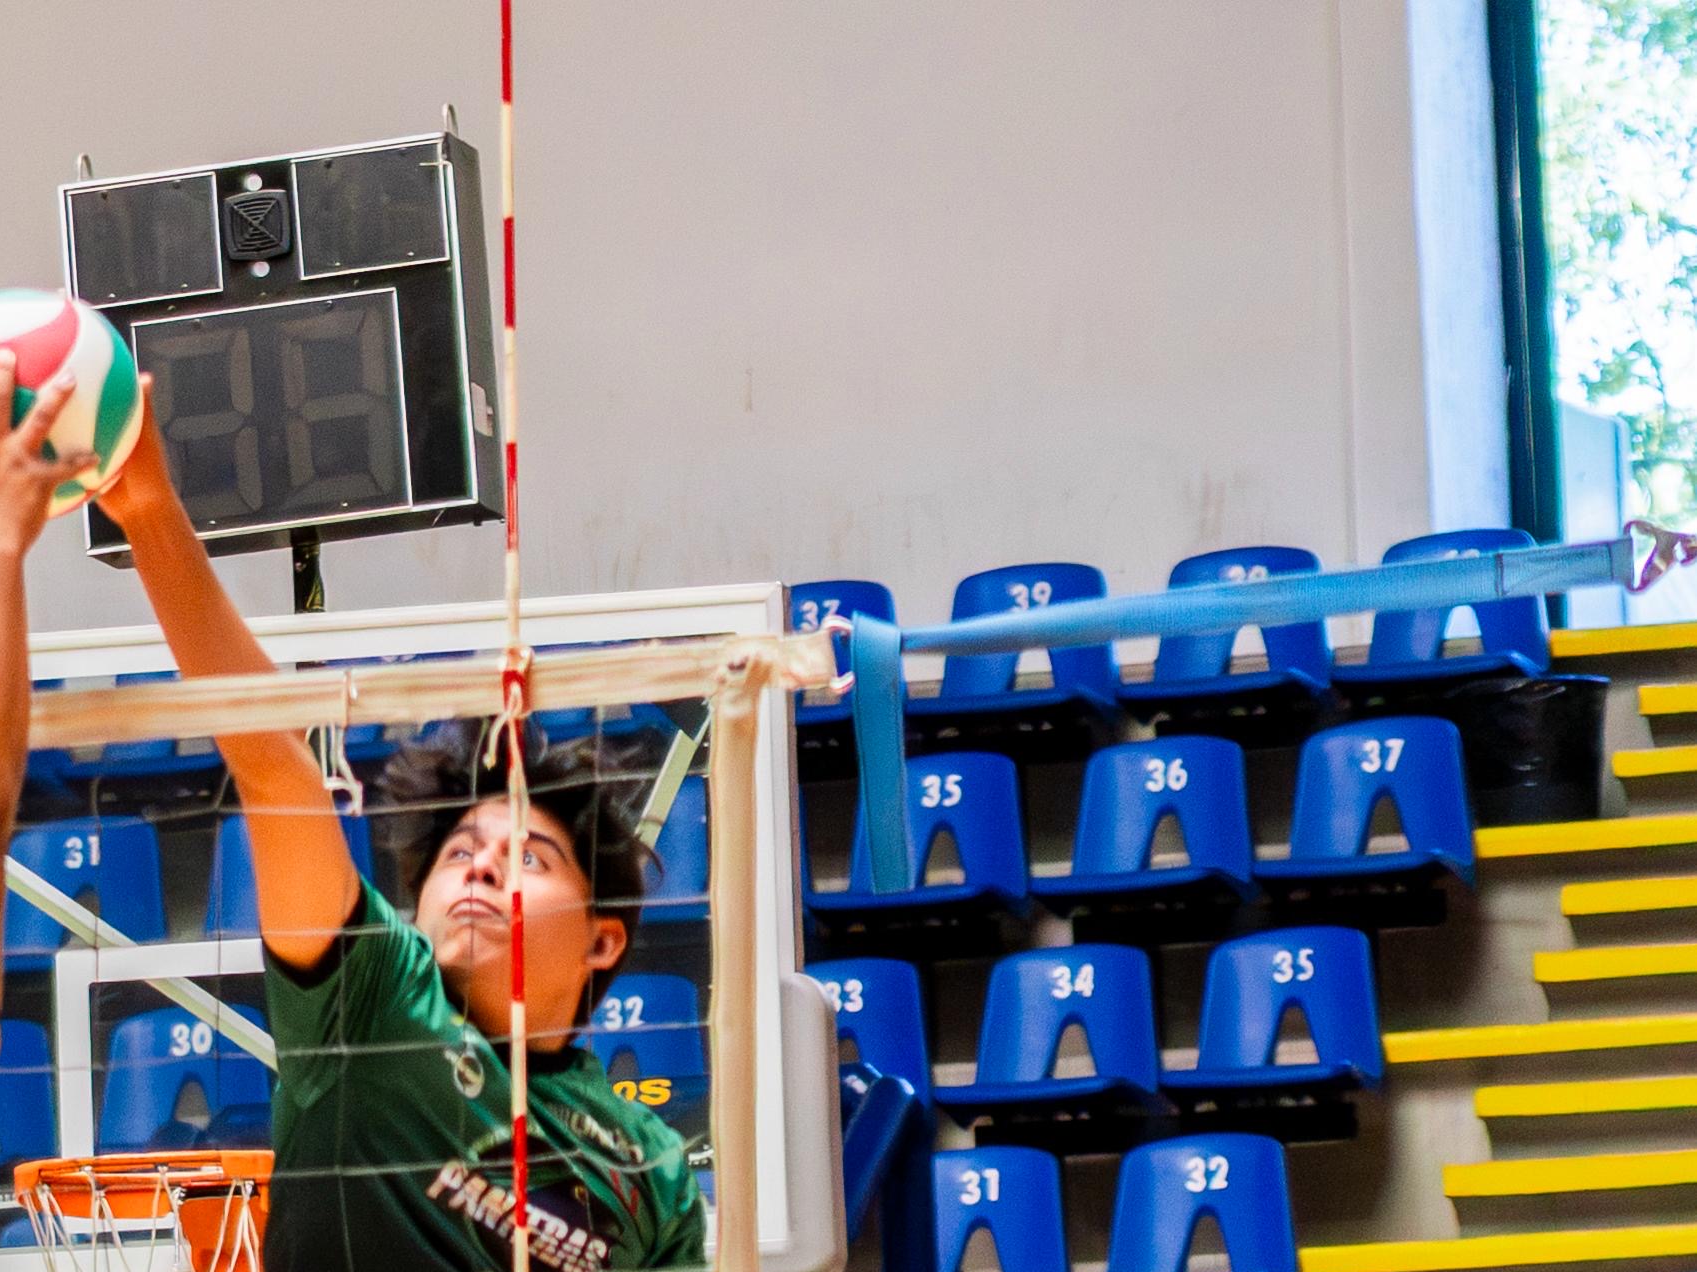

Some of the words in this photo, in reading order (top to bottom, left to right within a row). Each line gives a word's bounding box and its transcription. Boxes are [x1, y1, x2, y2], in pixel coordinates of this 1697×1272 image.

[1361, 737, 1405, 773] 37
[920, 774, 963, 808] 35
[1145, 758, 1188, 793] 36
[64, 836, 100, 870] 31
[1051, 965, 1095, 1001] 34
[1271, 949, 1315, 983] 35
[602, 996, 644, 1030] 32
[170, 1022, 213, 1057] 30
[961, 1168, 1001, 1205] 31
[1184, 1156, 1229, 1193] 32
